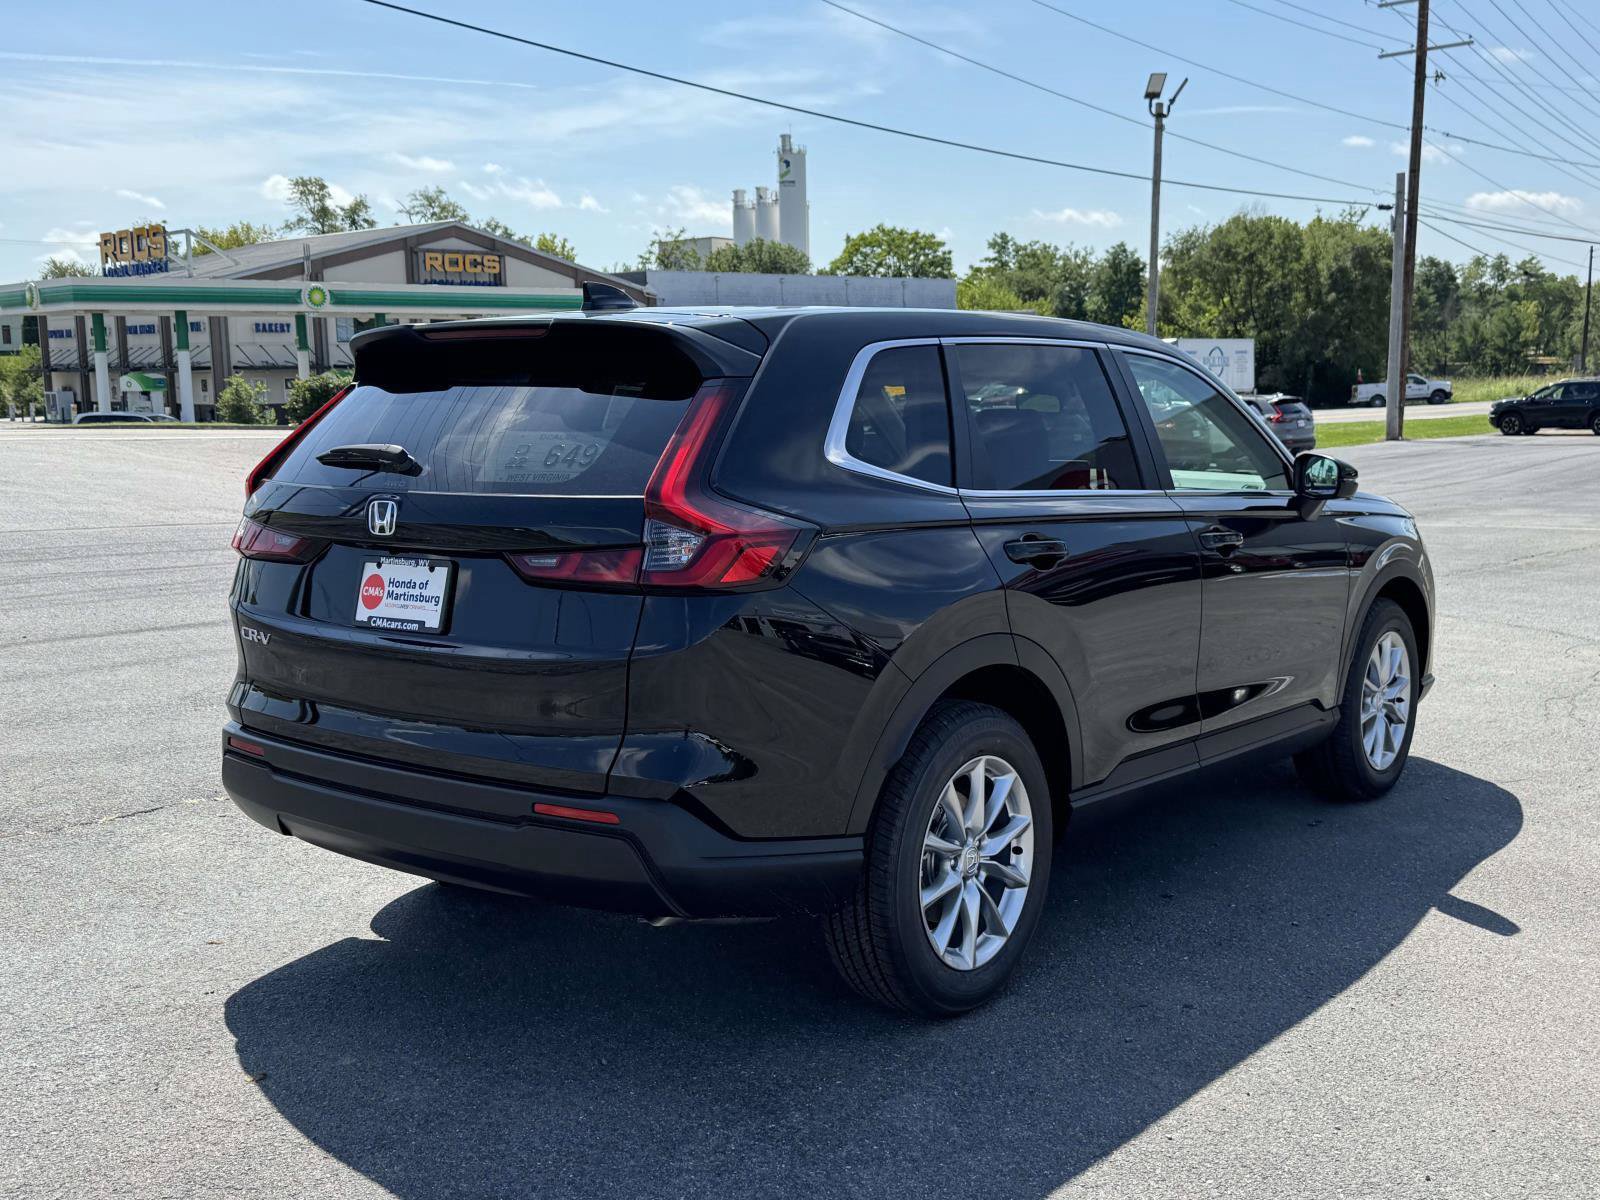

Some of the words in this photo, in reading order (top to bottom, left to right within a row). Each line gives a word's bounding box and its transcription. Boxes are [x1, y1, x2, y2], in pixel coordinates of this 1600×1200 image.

[100, 224, 168, 264] ROCS
[131, 259, 169, 276] MARKET
[424, 252, 501, 273] ROCS
[255, 322, 291, 333] BAKERY
[532, 472, 571, 481] VIRGINIA
[388, 578, 417, 589] Honda
[418, 581, 429, 590] of
[386, 590, 440, 606] Martinsburg
[370, 617, 419, 631] CMAcars.com
[241, 626, 271, 645] CR-V
